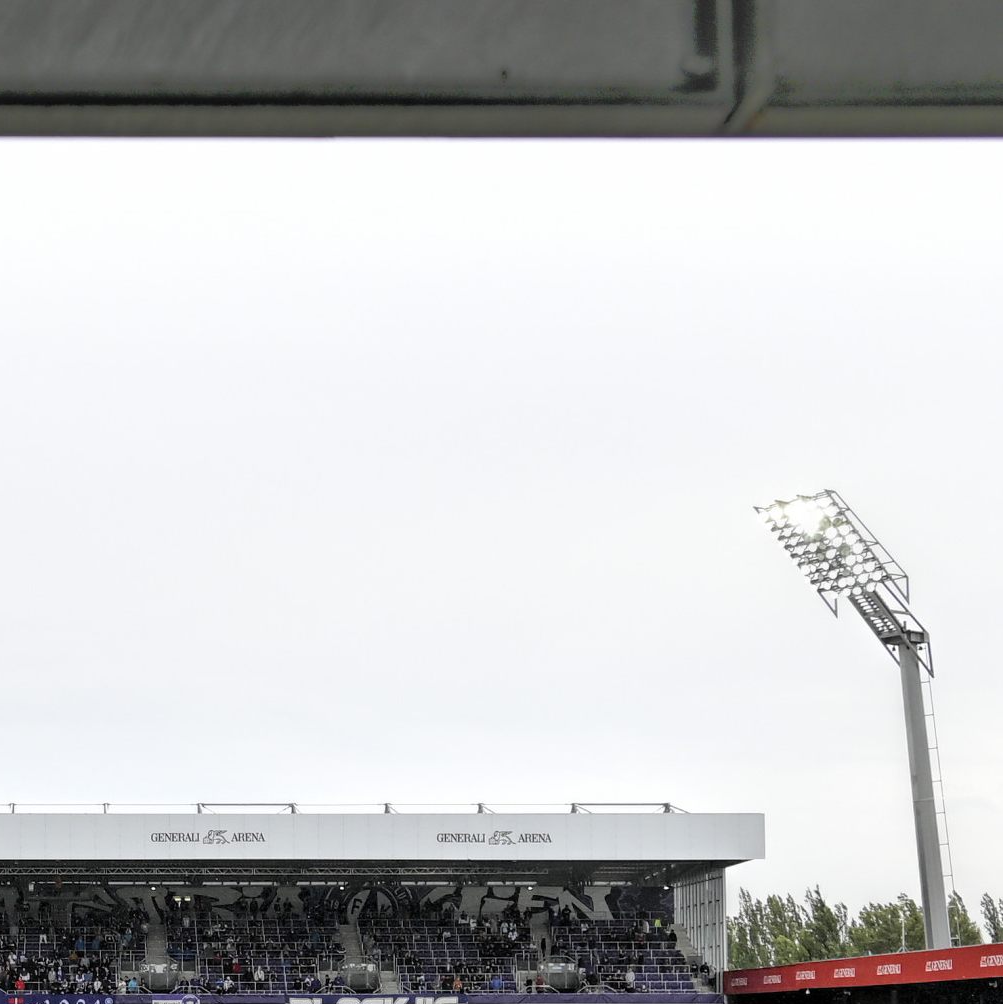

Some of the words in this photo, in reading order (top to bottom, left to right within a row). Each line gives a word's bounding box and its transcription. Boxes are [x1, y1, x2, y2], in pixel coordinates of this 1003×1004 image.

[150, 832, 200, 843] GENERALI
[231, 832, 266, 843] ARENA
[436, 832, 486, 843] GENERALI
[517, 832, 552, 843] ARENA
